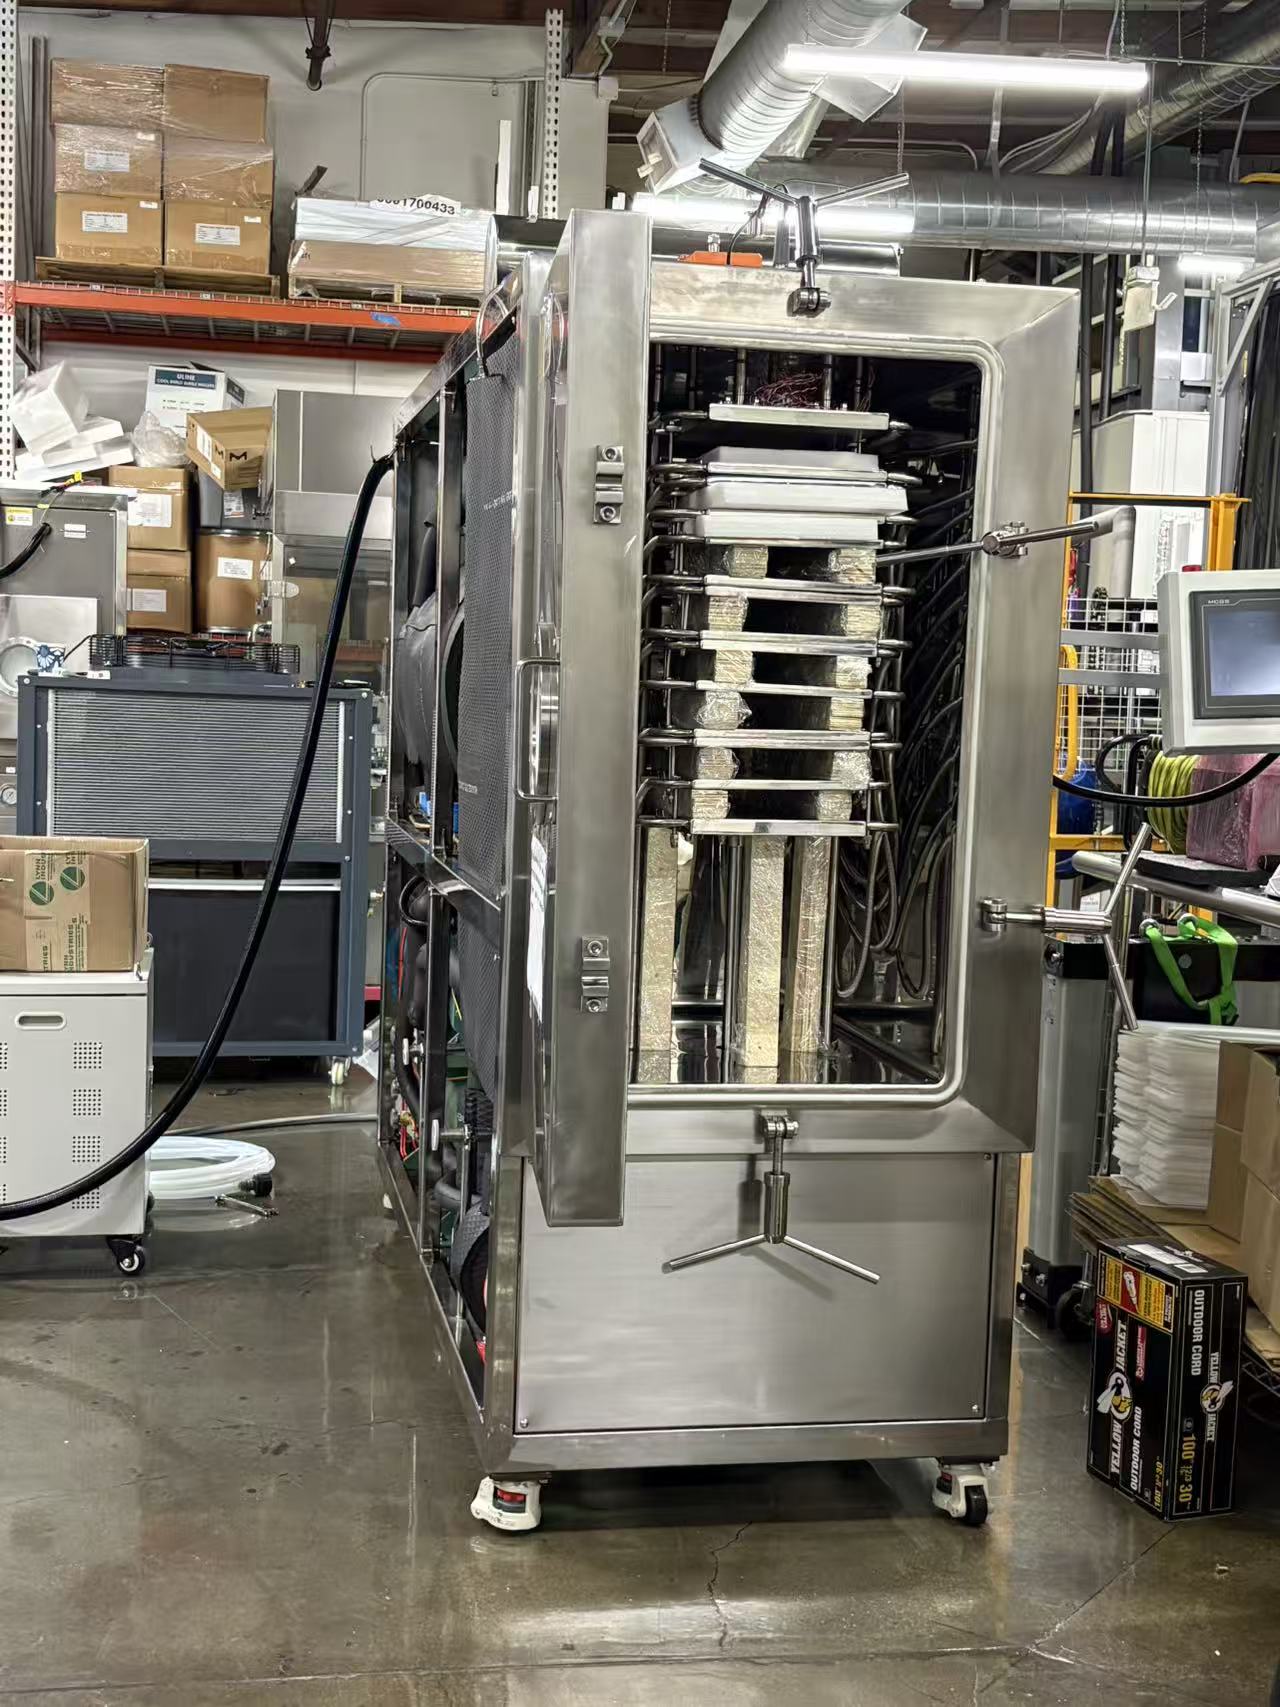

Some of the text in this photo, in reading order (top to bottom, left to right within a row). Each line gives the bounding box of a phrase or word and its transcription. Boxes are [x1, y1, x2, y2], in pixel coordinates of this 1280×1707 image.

[177, 373, 196, 382] ULINE
[1191, 1289, 1205, 1376] OUTDOOR CORD
[1110, 1319, 1127, 1474] YELLOW JACKET
[1206, 1351, 1220, 1442] YELLOW JACKET
[1130, 1405, 1142, 1491] OUTDOOR CORD
[1181, 1433, 1196, 1460] 100
[1179, 1484, 1193, 1503] 30
